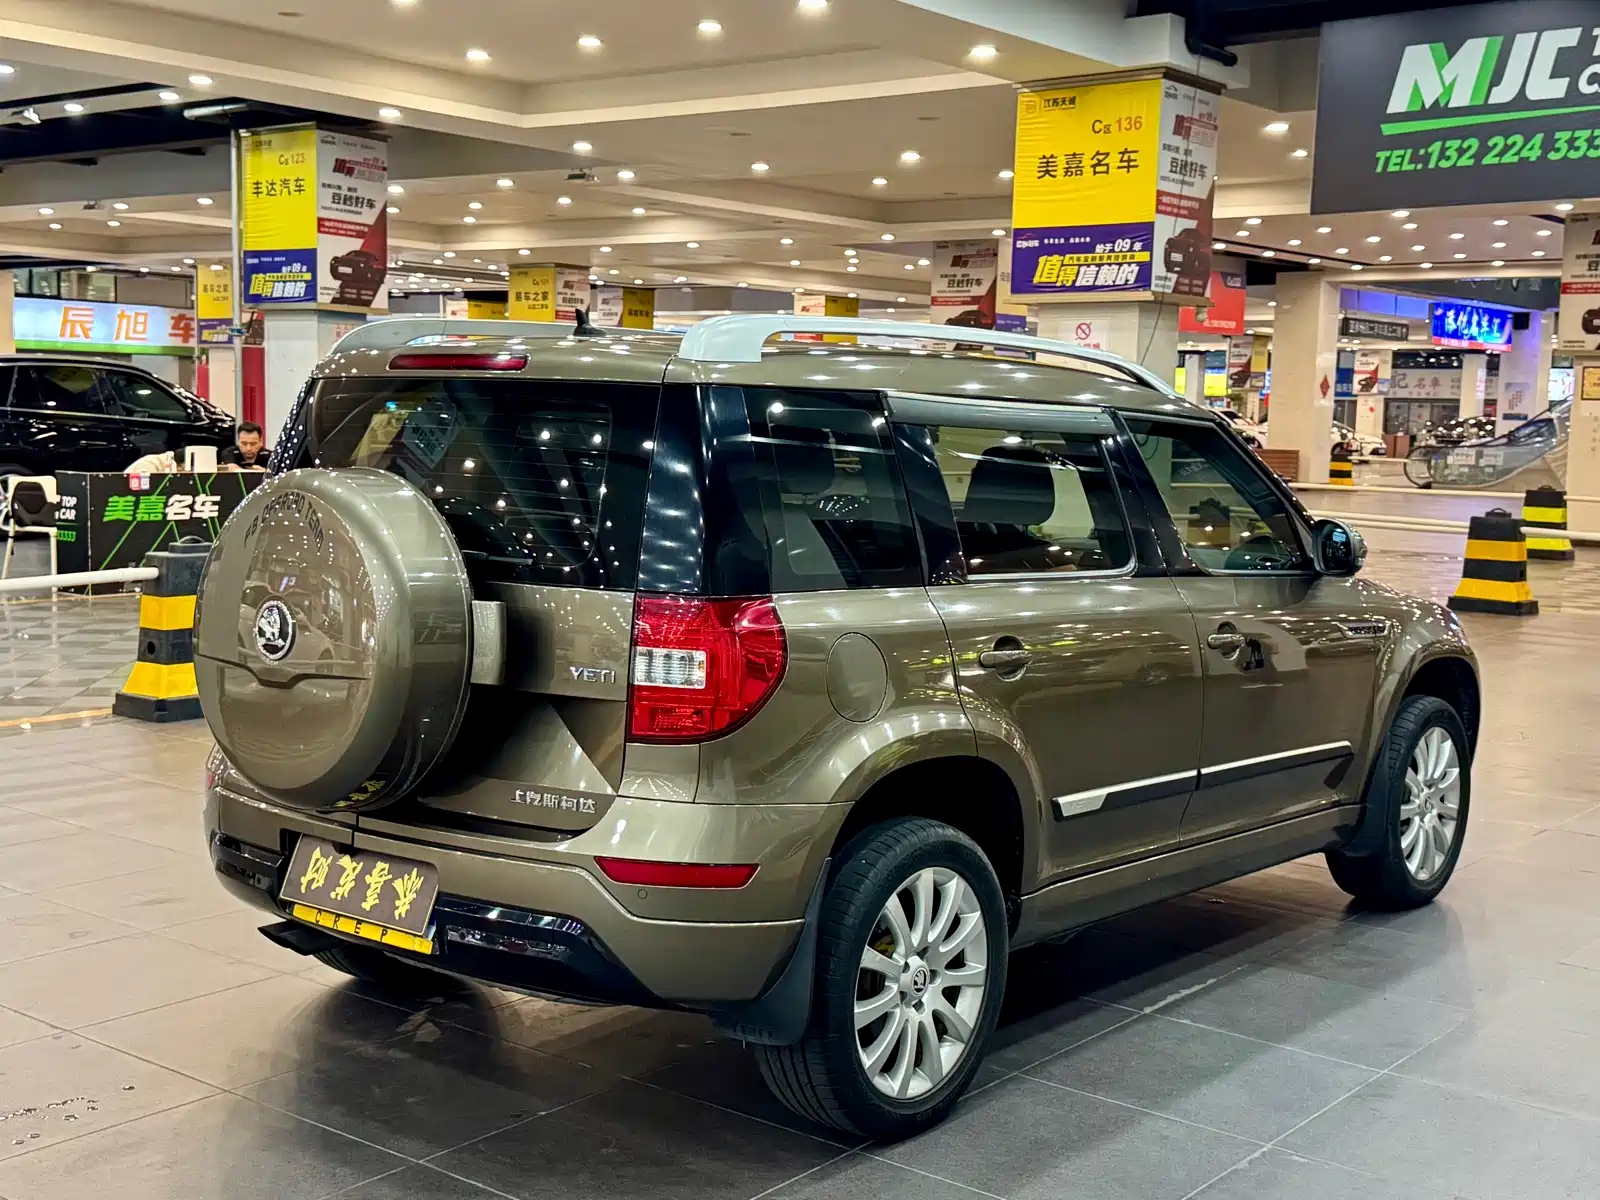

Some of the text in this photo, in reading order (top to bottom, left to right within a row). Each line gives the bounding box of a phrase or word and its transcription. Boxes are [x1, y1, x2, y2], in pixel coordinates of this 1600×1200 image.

[1386, 27, 1583, 114] MJC
[1116, 116, 1142, 132] 136
[1481, 133, 1544, 165] 224
[1037, 148, 1140, 179] 美嘉名车
[252, 177, 306, 198] 丰达汽车
[1033, 254, 1139, 287] 值得信赖的
[60, 508, 76, 520] CAR
[62, 496, 77, 507] TOP
[103, 494, 221, 522] 美嘉名车
[261, 492, 306, 523] OFFROAD
[569, 666, 616, 684] YETI
[510, 789, 597, 814] 上汽斯柯达
